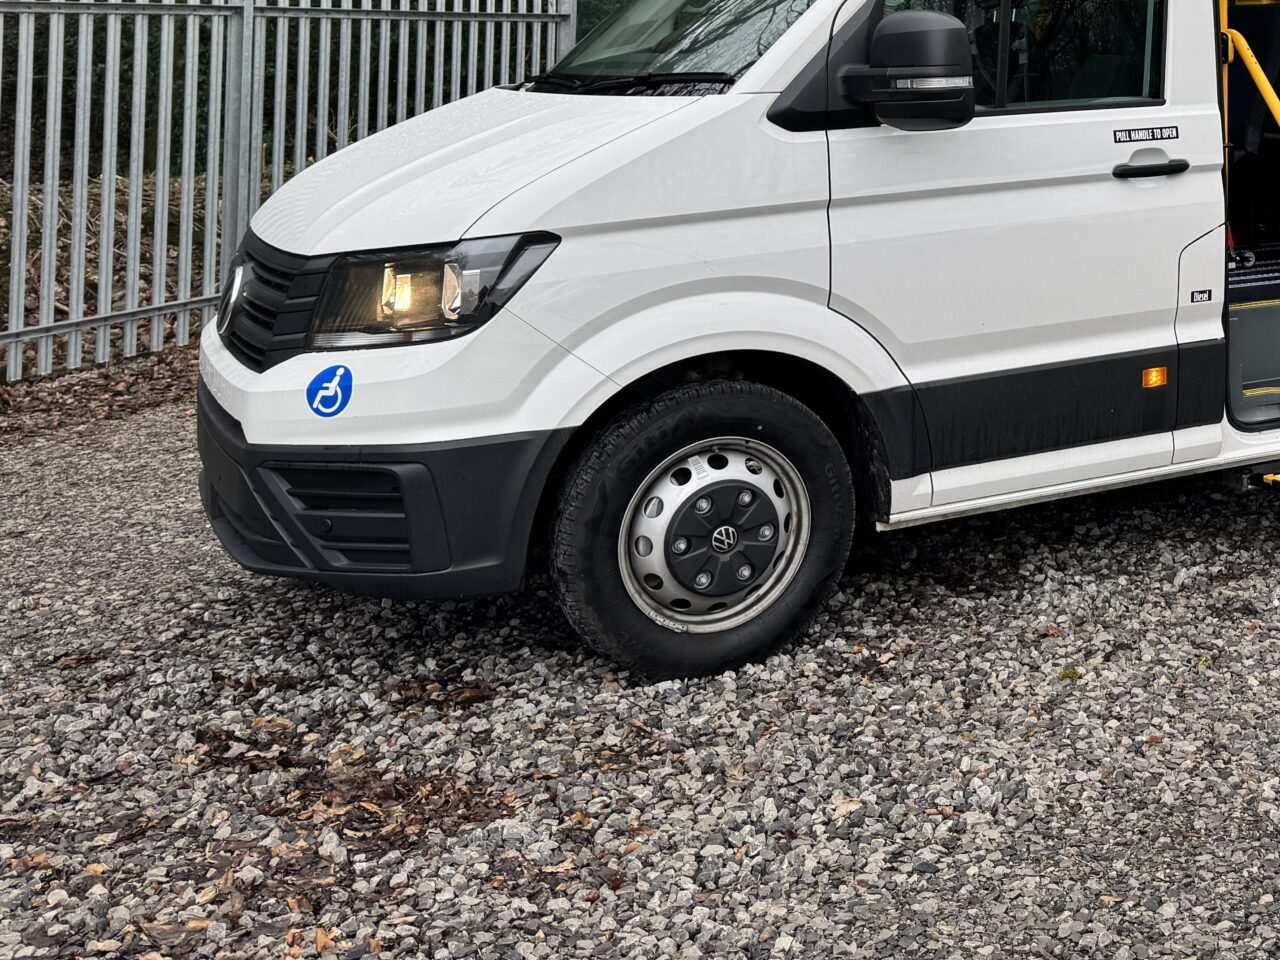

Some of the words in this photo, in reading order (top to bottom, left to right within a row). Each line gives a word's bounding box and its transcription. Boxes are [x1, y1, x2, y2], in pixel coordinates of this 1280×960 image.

[1116, 131, 1130, 141] PULL
[1130, 129, 1153, 141] HANDLE
[1153, 128, 1161, 139] TO
[1162, 128, 1176, 137] OPEN
[1193, 290, 1208, 301] Diesel
